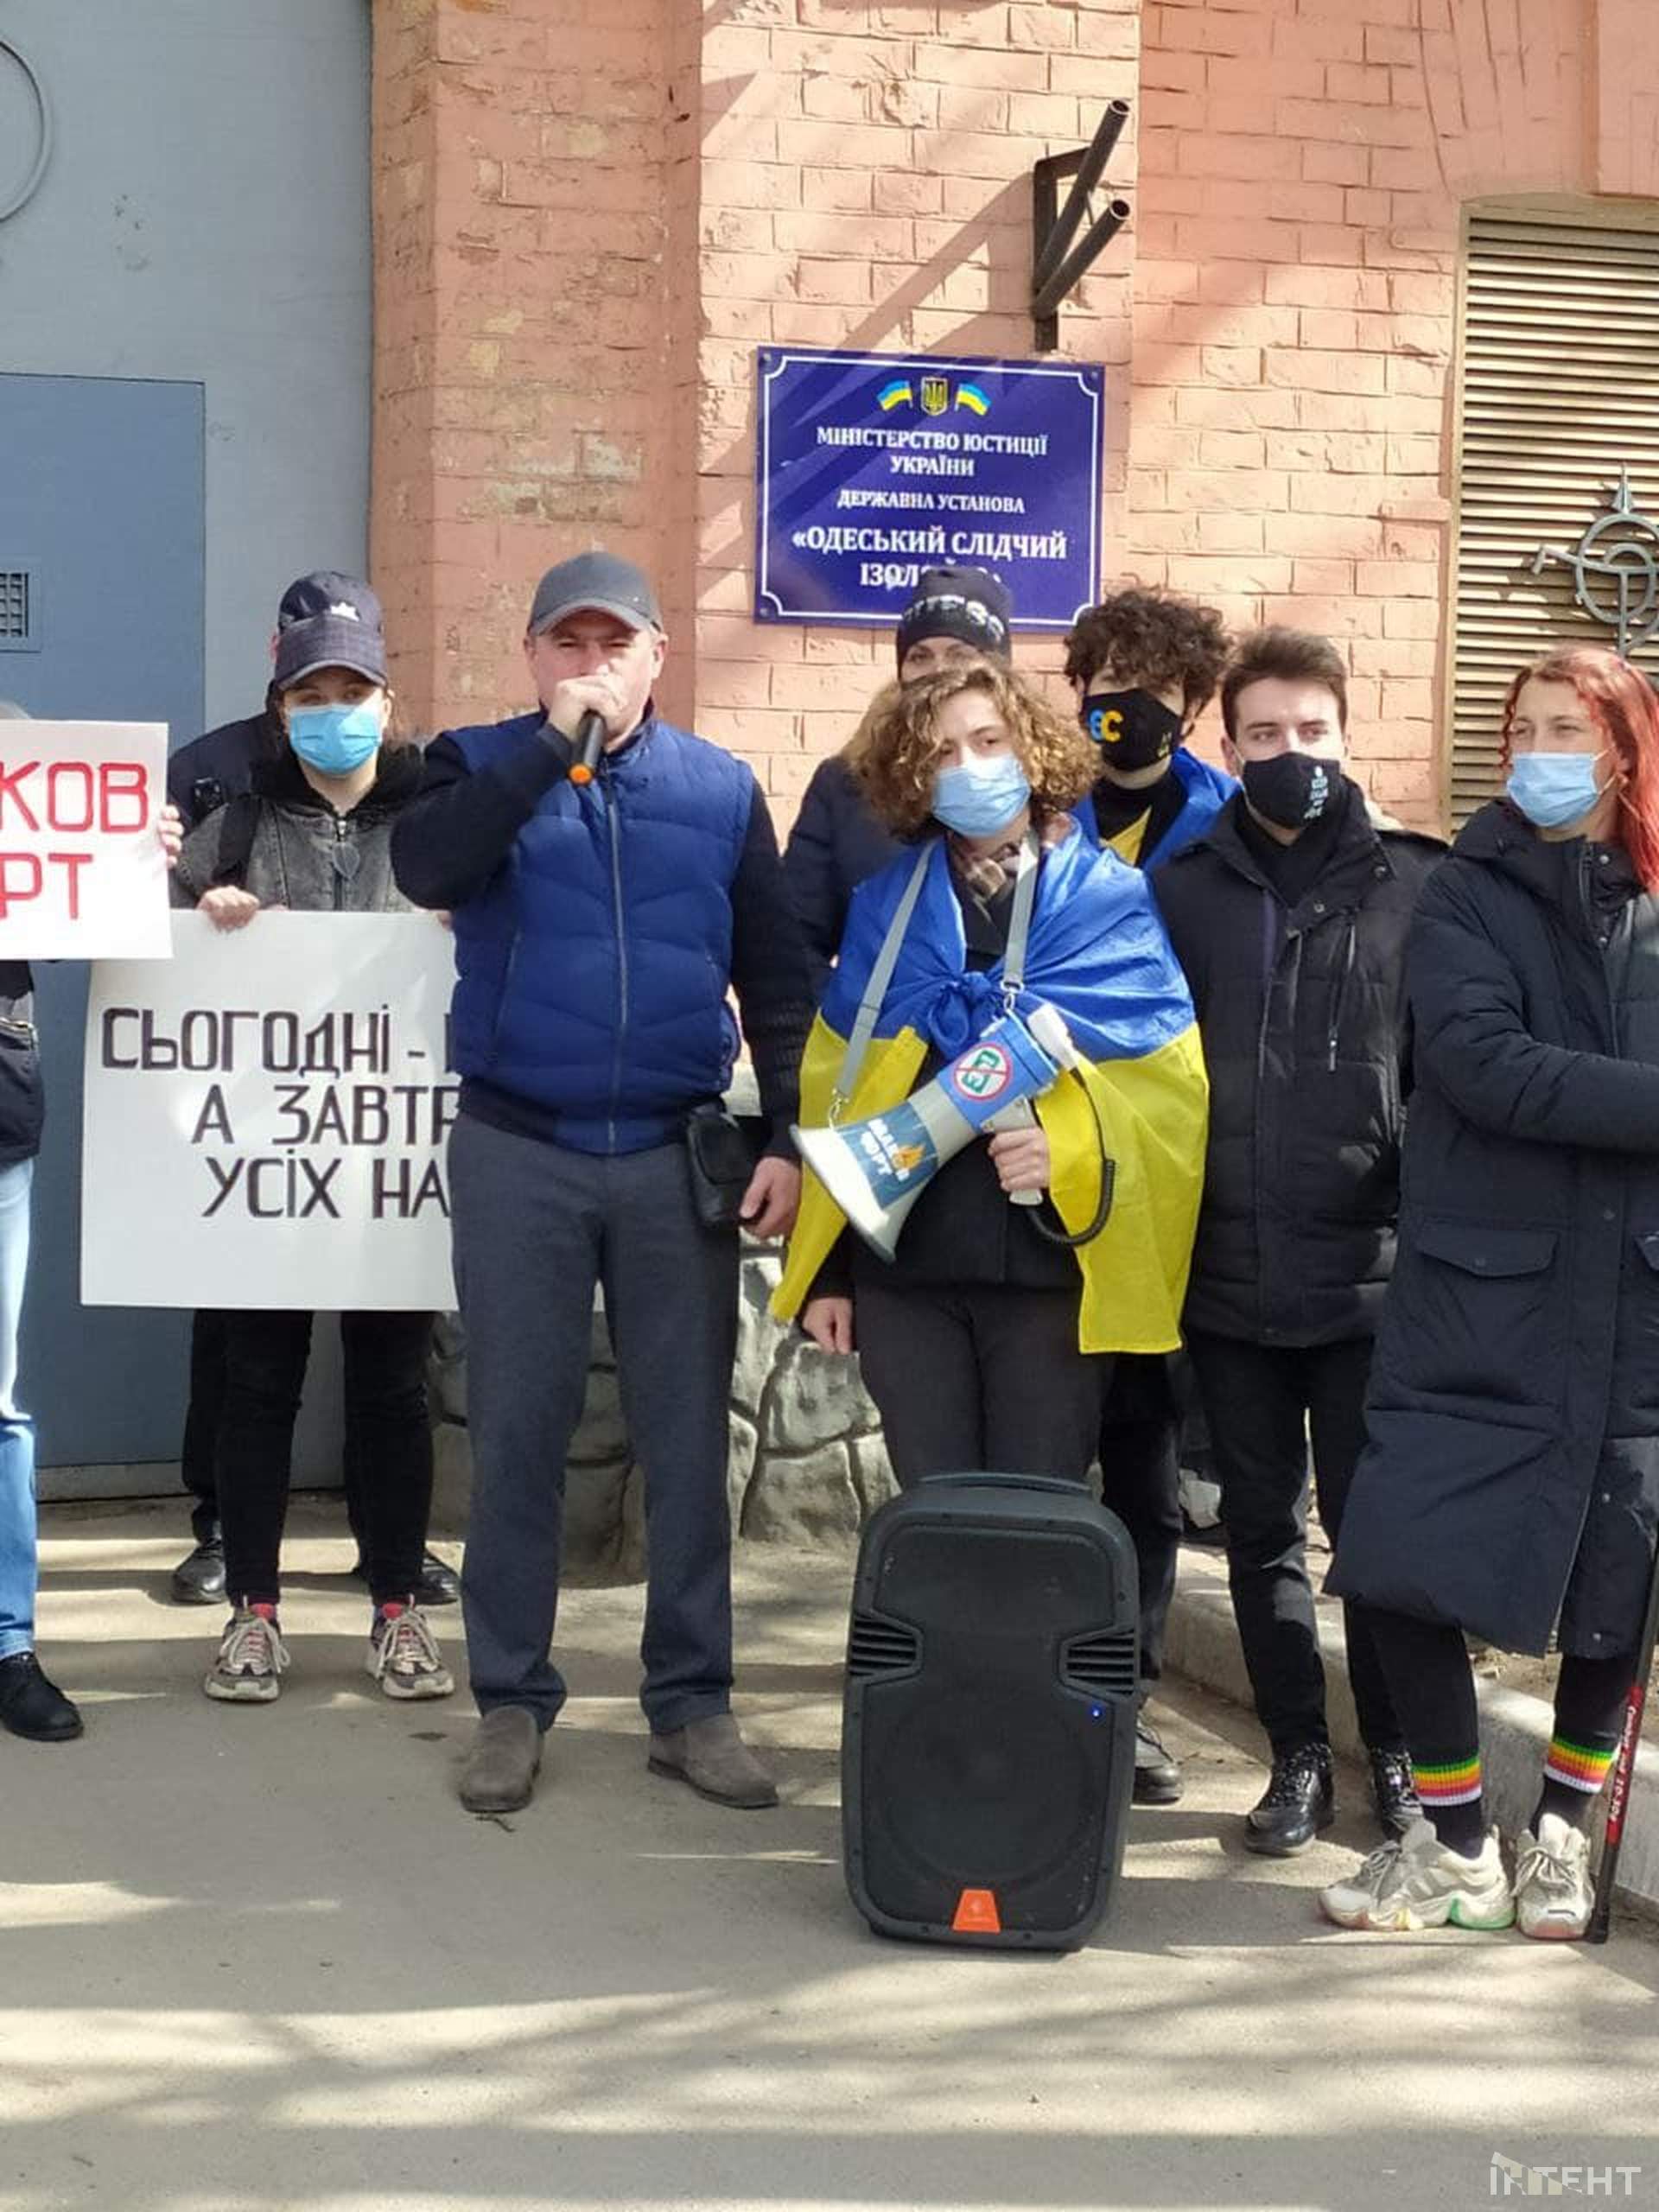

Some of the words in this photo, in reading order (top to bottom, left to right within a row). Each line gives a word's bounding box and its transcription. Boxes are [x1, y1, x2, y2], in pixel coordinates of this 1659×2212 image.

[817, 427, 959, 450] МІНІСТЕРСТВО
[963, 432, 1048, 457] ЮСТИЦІЇ
[890, 454, 975, 476] УКРАЇНИ
[836, 488, 934, 509] ДЕРЖАВНА
[938, 494, 1026, 514] УСТАНОВА
[791, 524, 946, 555] «ОДЕСЬКИЙ
[951, 531, 1067, 562] СЛІДЧИЙ
[0, 853, 93, 920] РТ
[192, 1084, 235, 1145] А
[372, 1159, 450, 1218] НА
